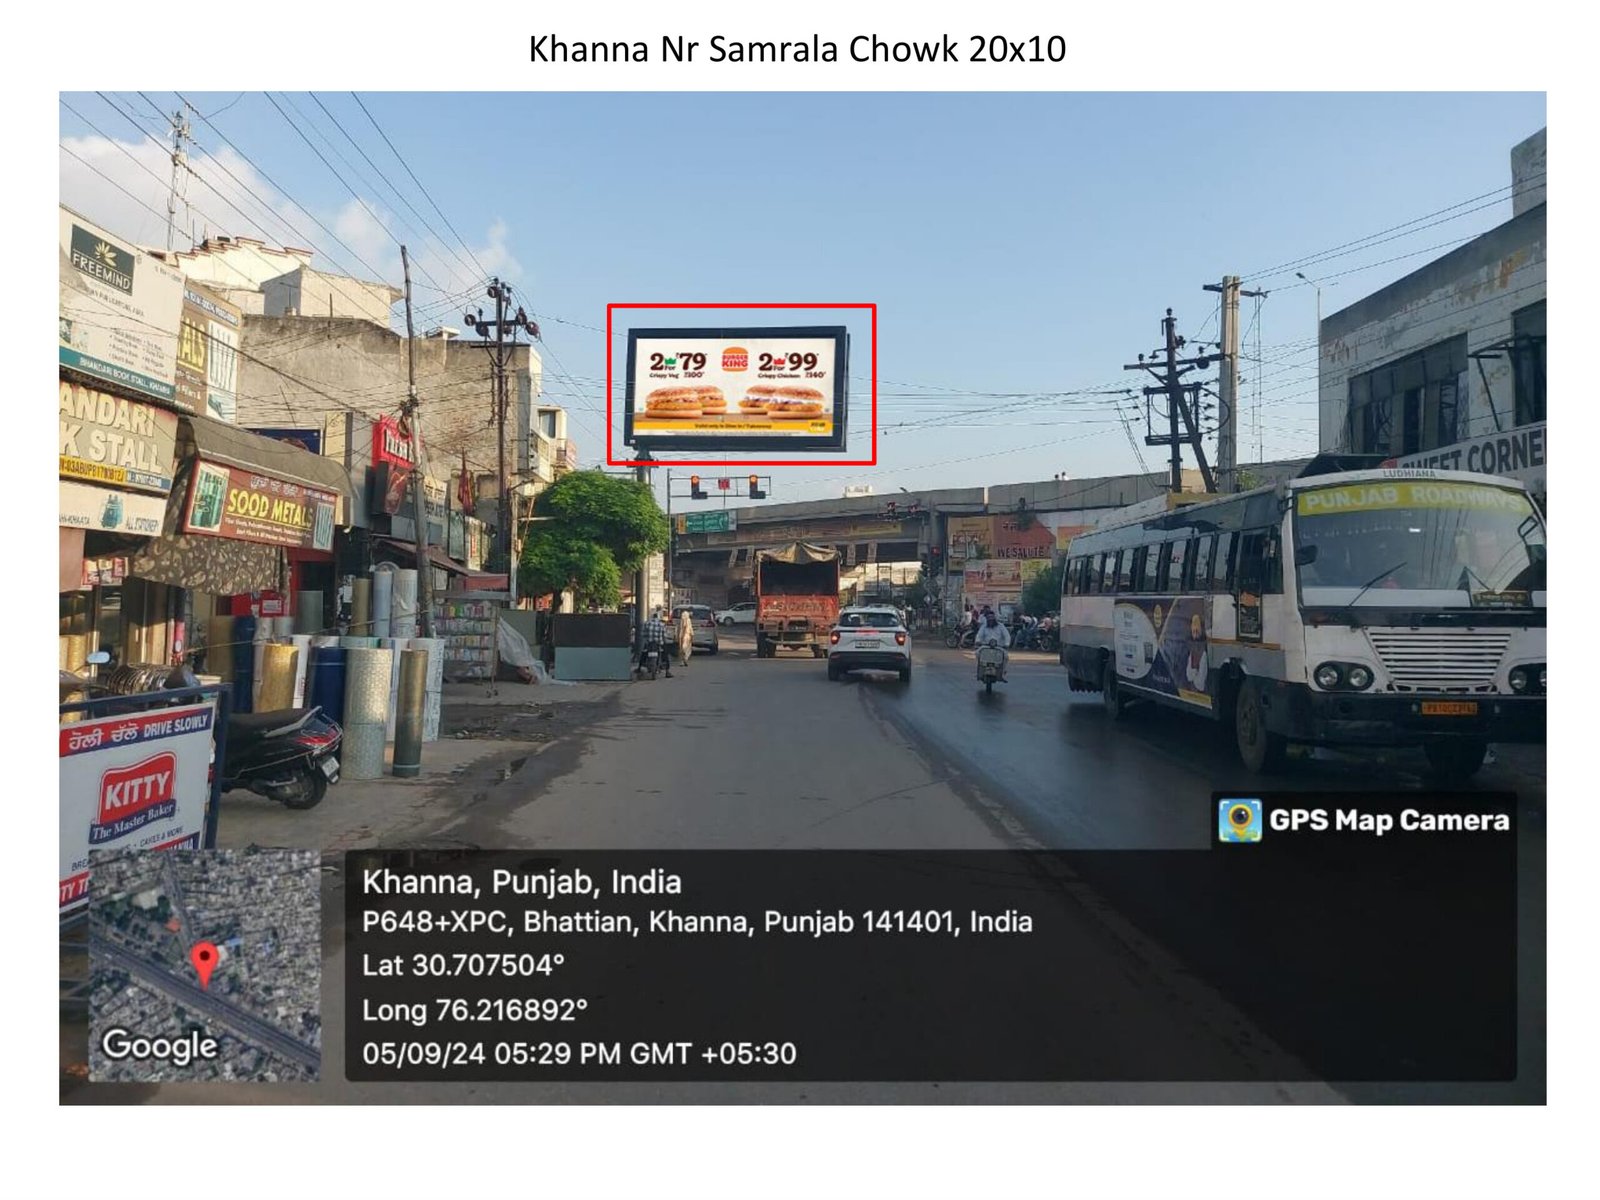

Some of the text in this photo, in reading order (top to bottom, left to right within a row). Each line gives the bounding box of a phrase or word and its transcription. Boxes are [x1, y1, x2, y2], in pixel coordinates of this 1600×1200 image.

[73, 253, 132, 290] FREEMIND
[650, 352, 664, 371] 2
[721, 360, 749, 369] KING
[759, 352, 773, 371] 2
[89, 429, 163, 474] STALL
[1467, 428, 1547, 474] CORNE
[1383, 469, 1436, 478] LUDHIANA
[227, 488, 269, 518] SOOD
[271, 499, 313, 528] METALS
[1305, 485, 1521, 509] PUNJAB ROADWAYS
[997, 546, 1045, 558] WE SALUTE
[143, 714, 208, 738] DRIVE SLOWLY
[105, 770, 171, 811] KITTY
[93, 802, 174, 841] The Master Baker
